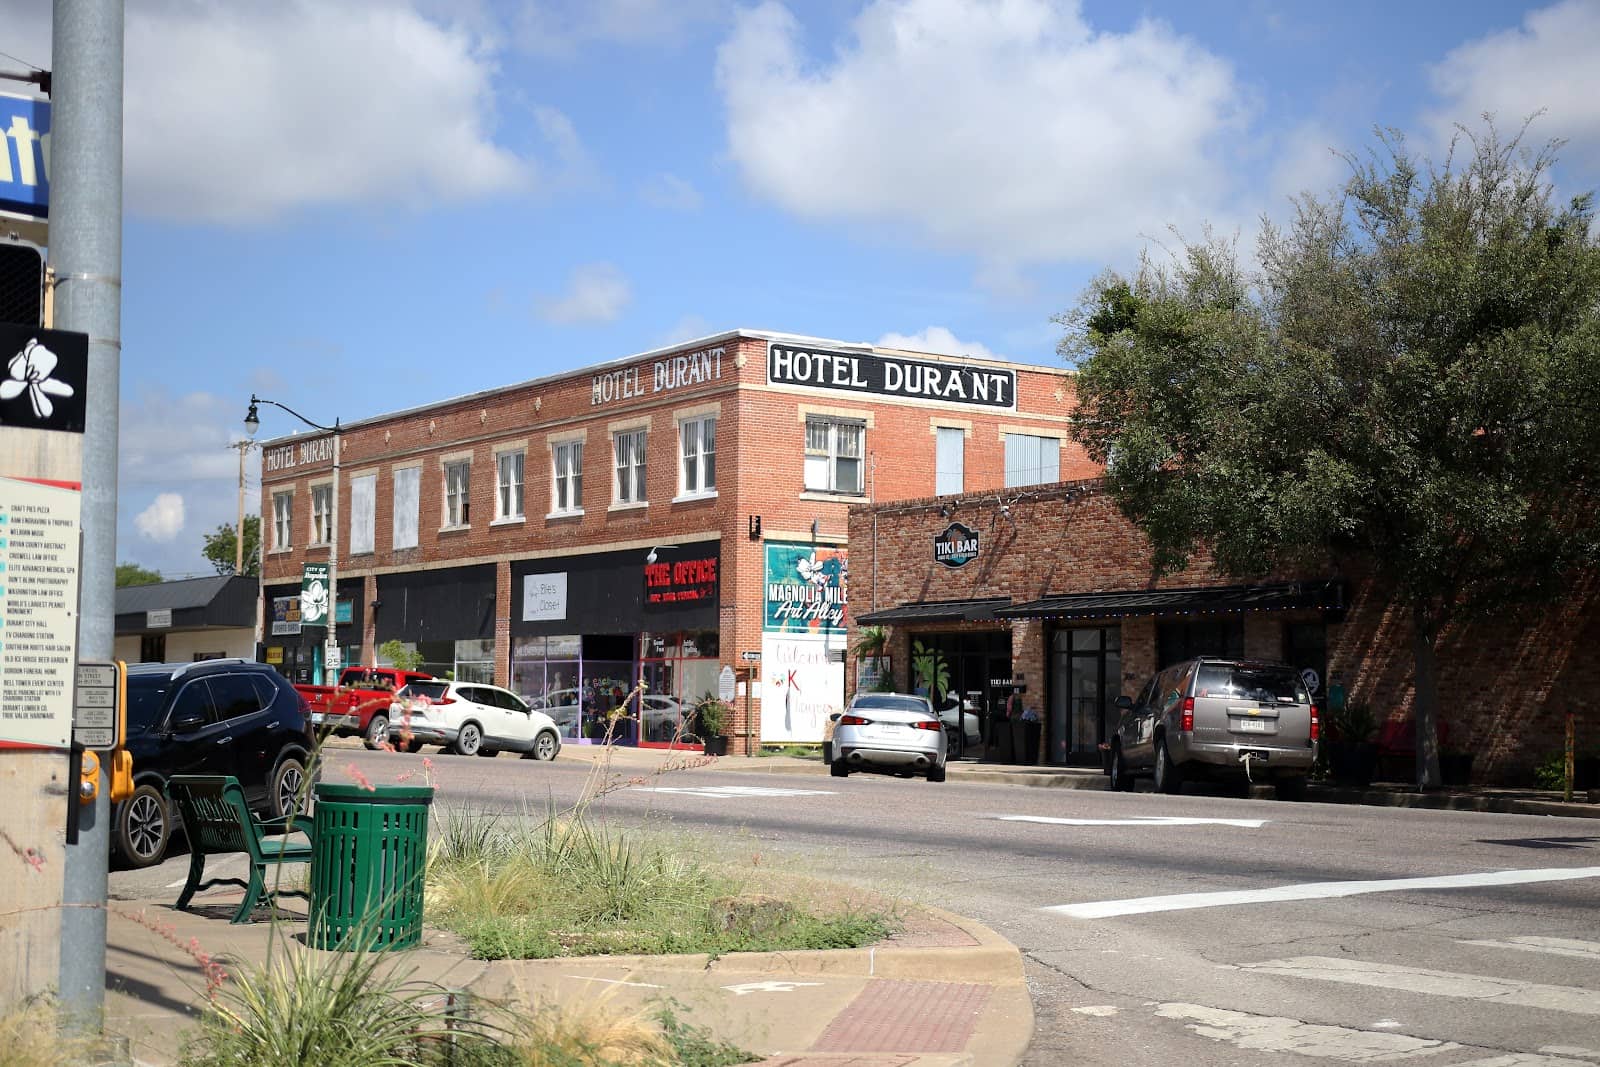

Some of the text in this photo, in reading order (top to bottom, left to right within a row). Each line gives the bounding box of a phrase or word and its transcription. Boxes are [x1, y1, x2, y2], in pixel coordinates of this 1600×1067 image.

[591, 347, 726, 405] HOTEL DURANT
[773, 349, 1008, 402] HOTEL DURANT
[267, 437, 336, 471] HOTEL DURAN
[936, 539, 978, 555] TIKI BAR
[645, 558, 717, 587] THE OFFICE
[769, 584, 848, 604] MAGNOLIA MILE
[774, 600, 844, 626] Art Alley
[328, 658, 340, 666] 25
